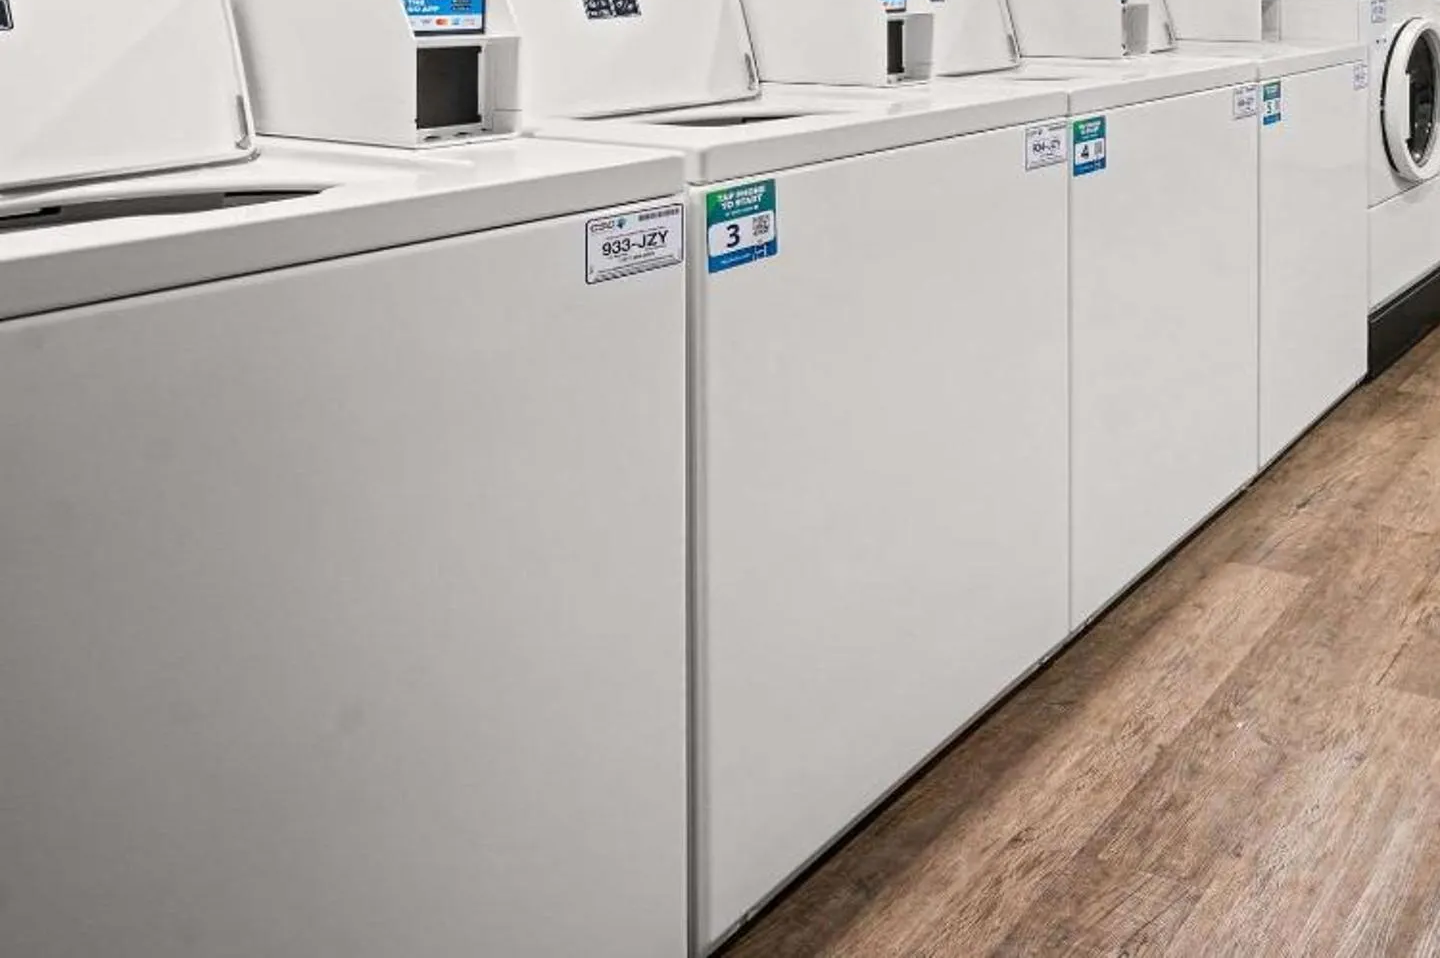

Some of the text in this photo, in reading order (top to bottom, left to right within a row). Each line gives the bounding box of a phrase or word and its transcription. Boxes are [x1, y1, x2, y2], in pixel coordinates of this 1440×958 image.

[716, 192, 735, 202] TAP
[721, 194, 762, 210] TO START
[602, 230, 669, 256] 933-JZY
[726, 223, 741, 248] 3
